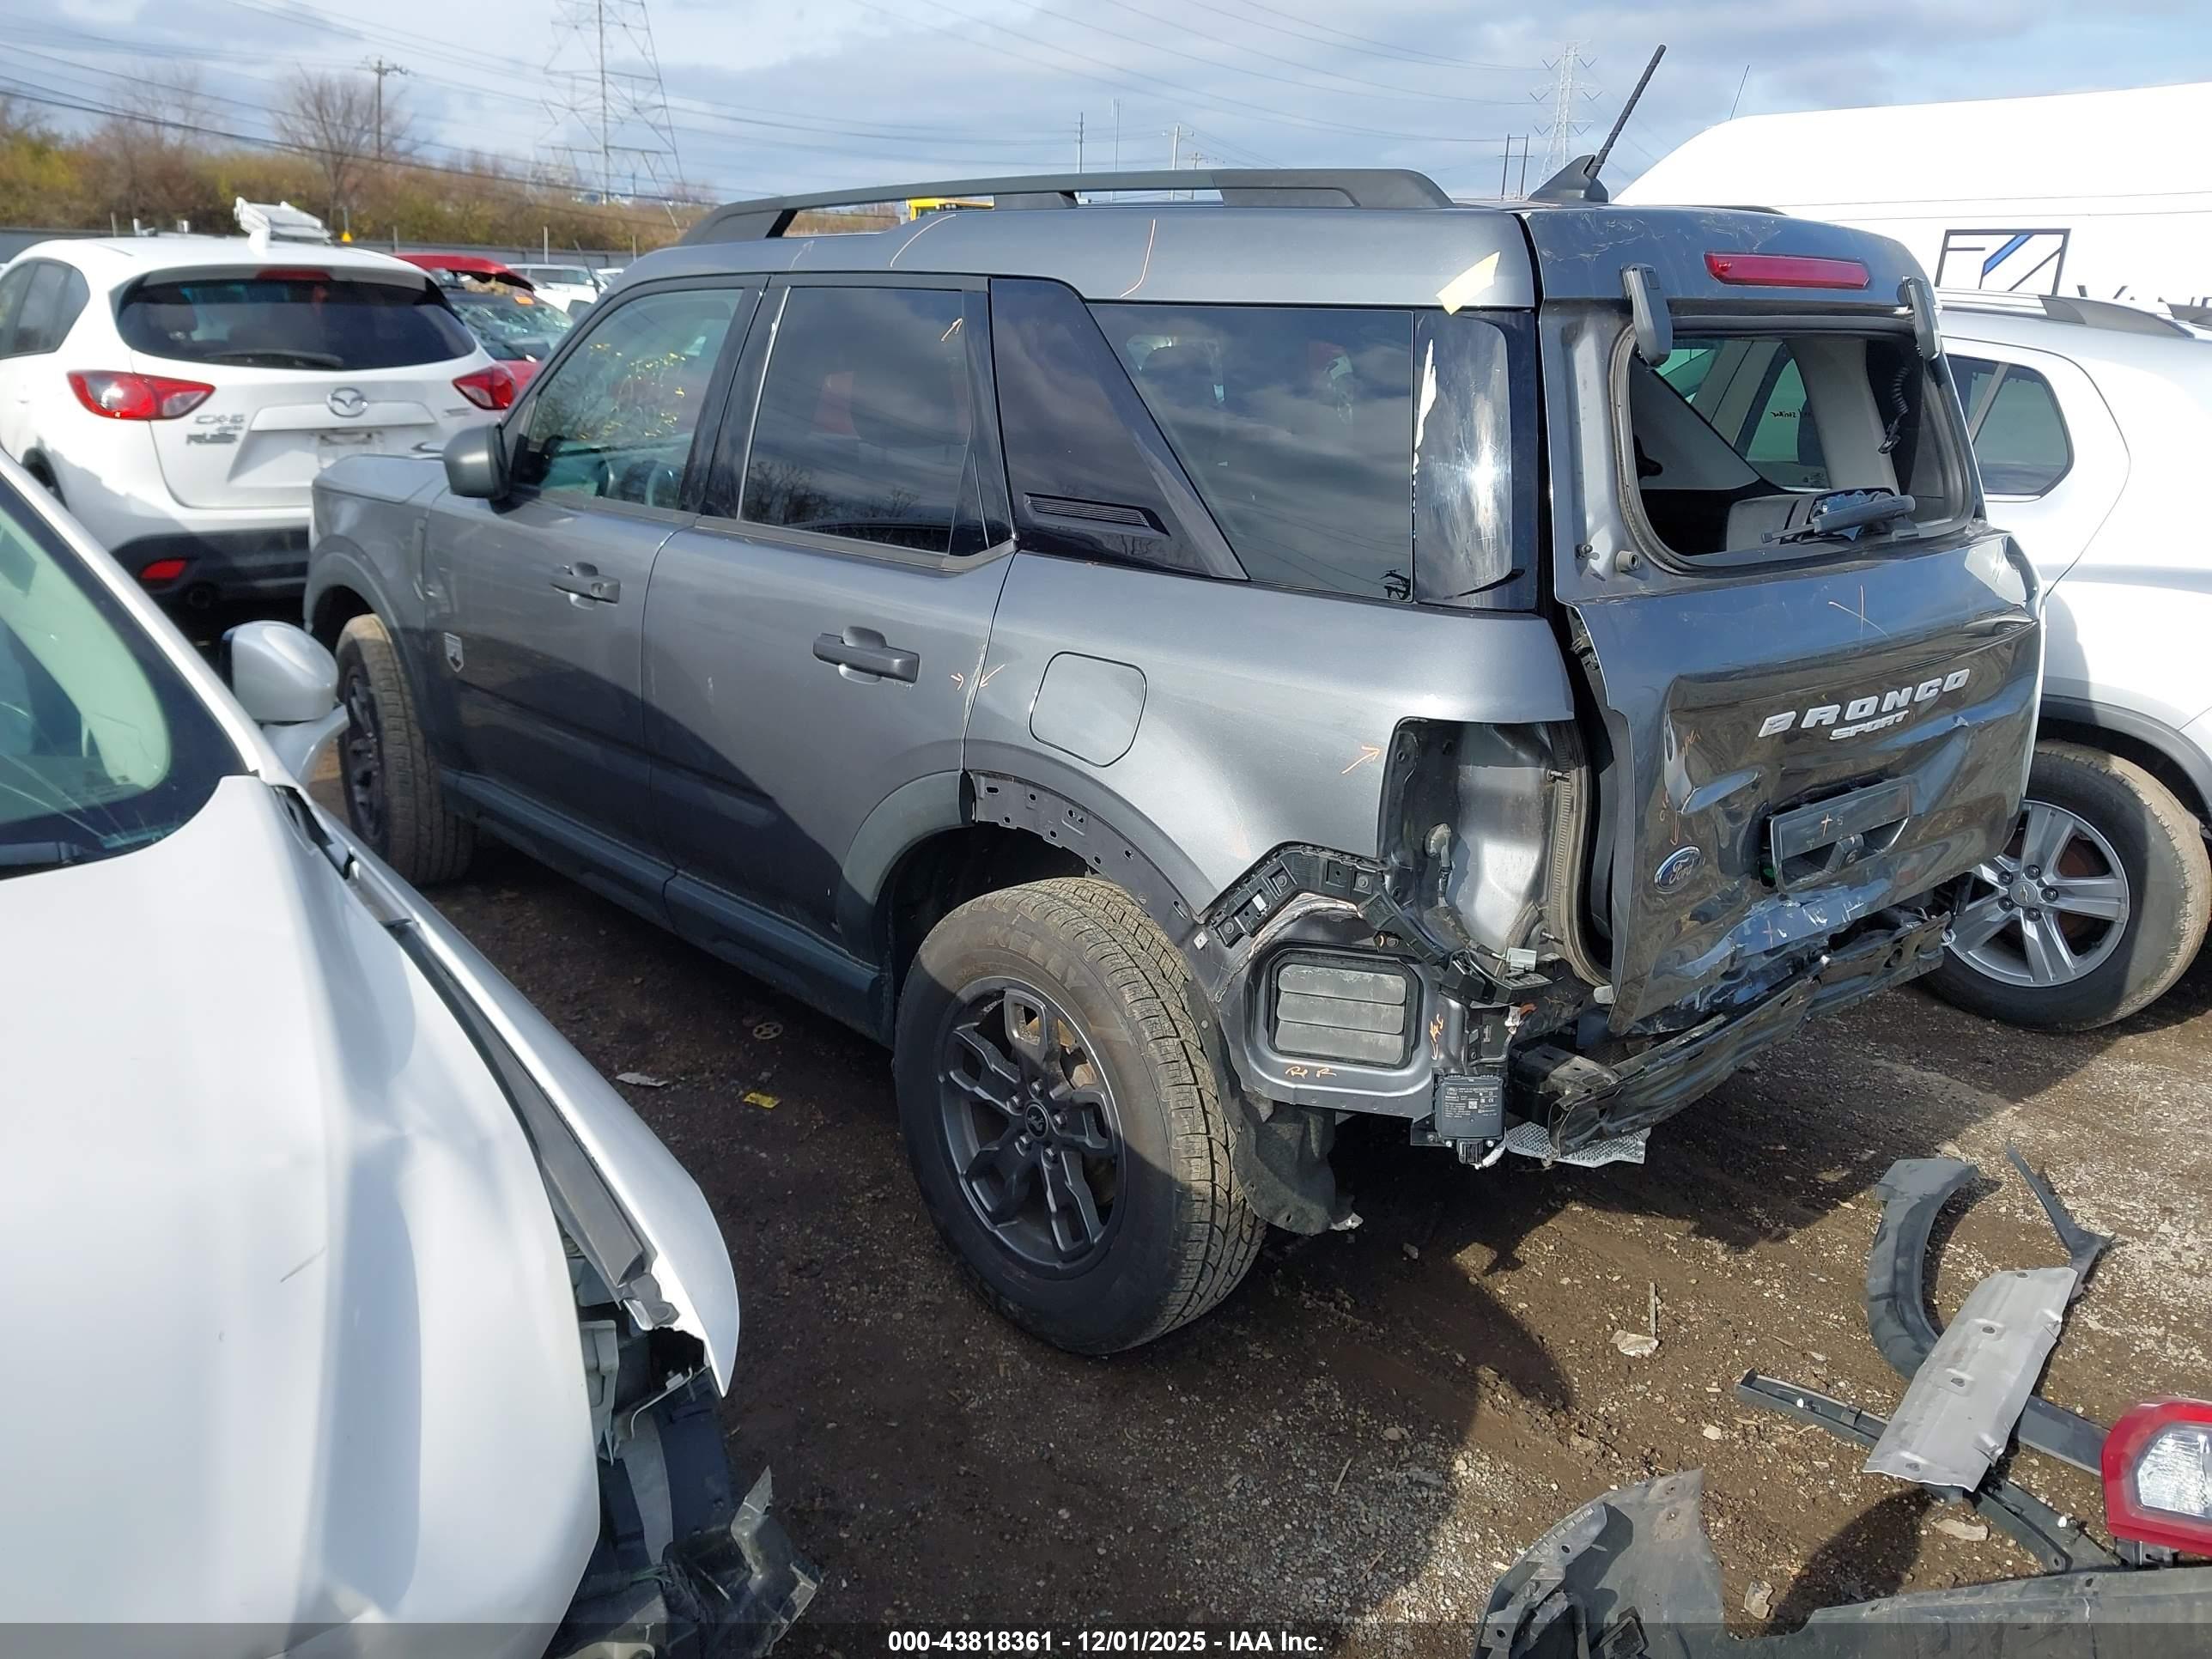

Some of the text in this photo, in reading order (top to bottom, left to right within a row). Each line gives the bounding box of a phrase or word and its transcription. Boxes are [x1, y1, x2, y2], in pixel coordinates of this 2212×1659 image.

[1758, 668, 1971, 738] BRONCO
[1829, 709, 1910, 741] SPORT
[986, 924, 1088, 991] KELLY
